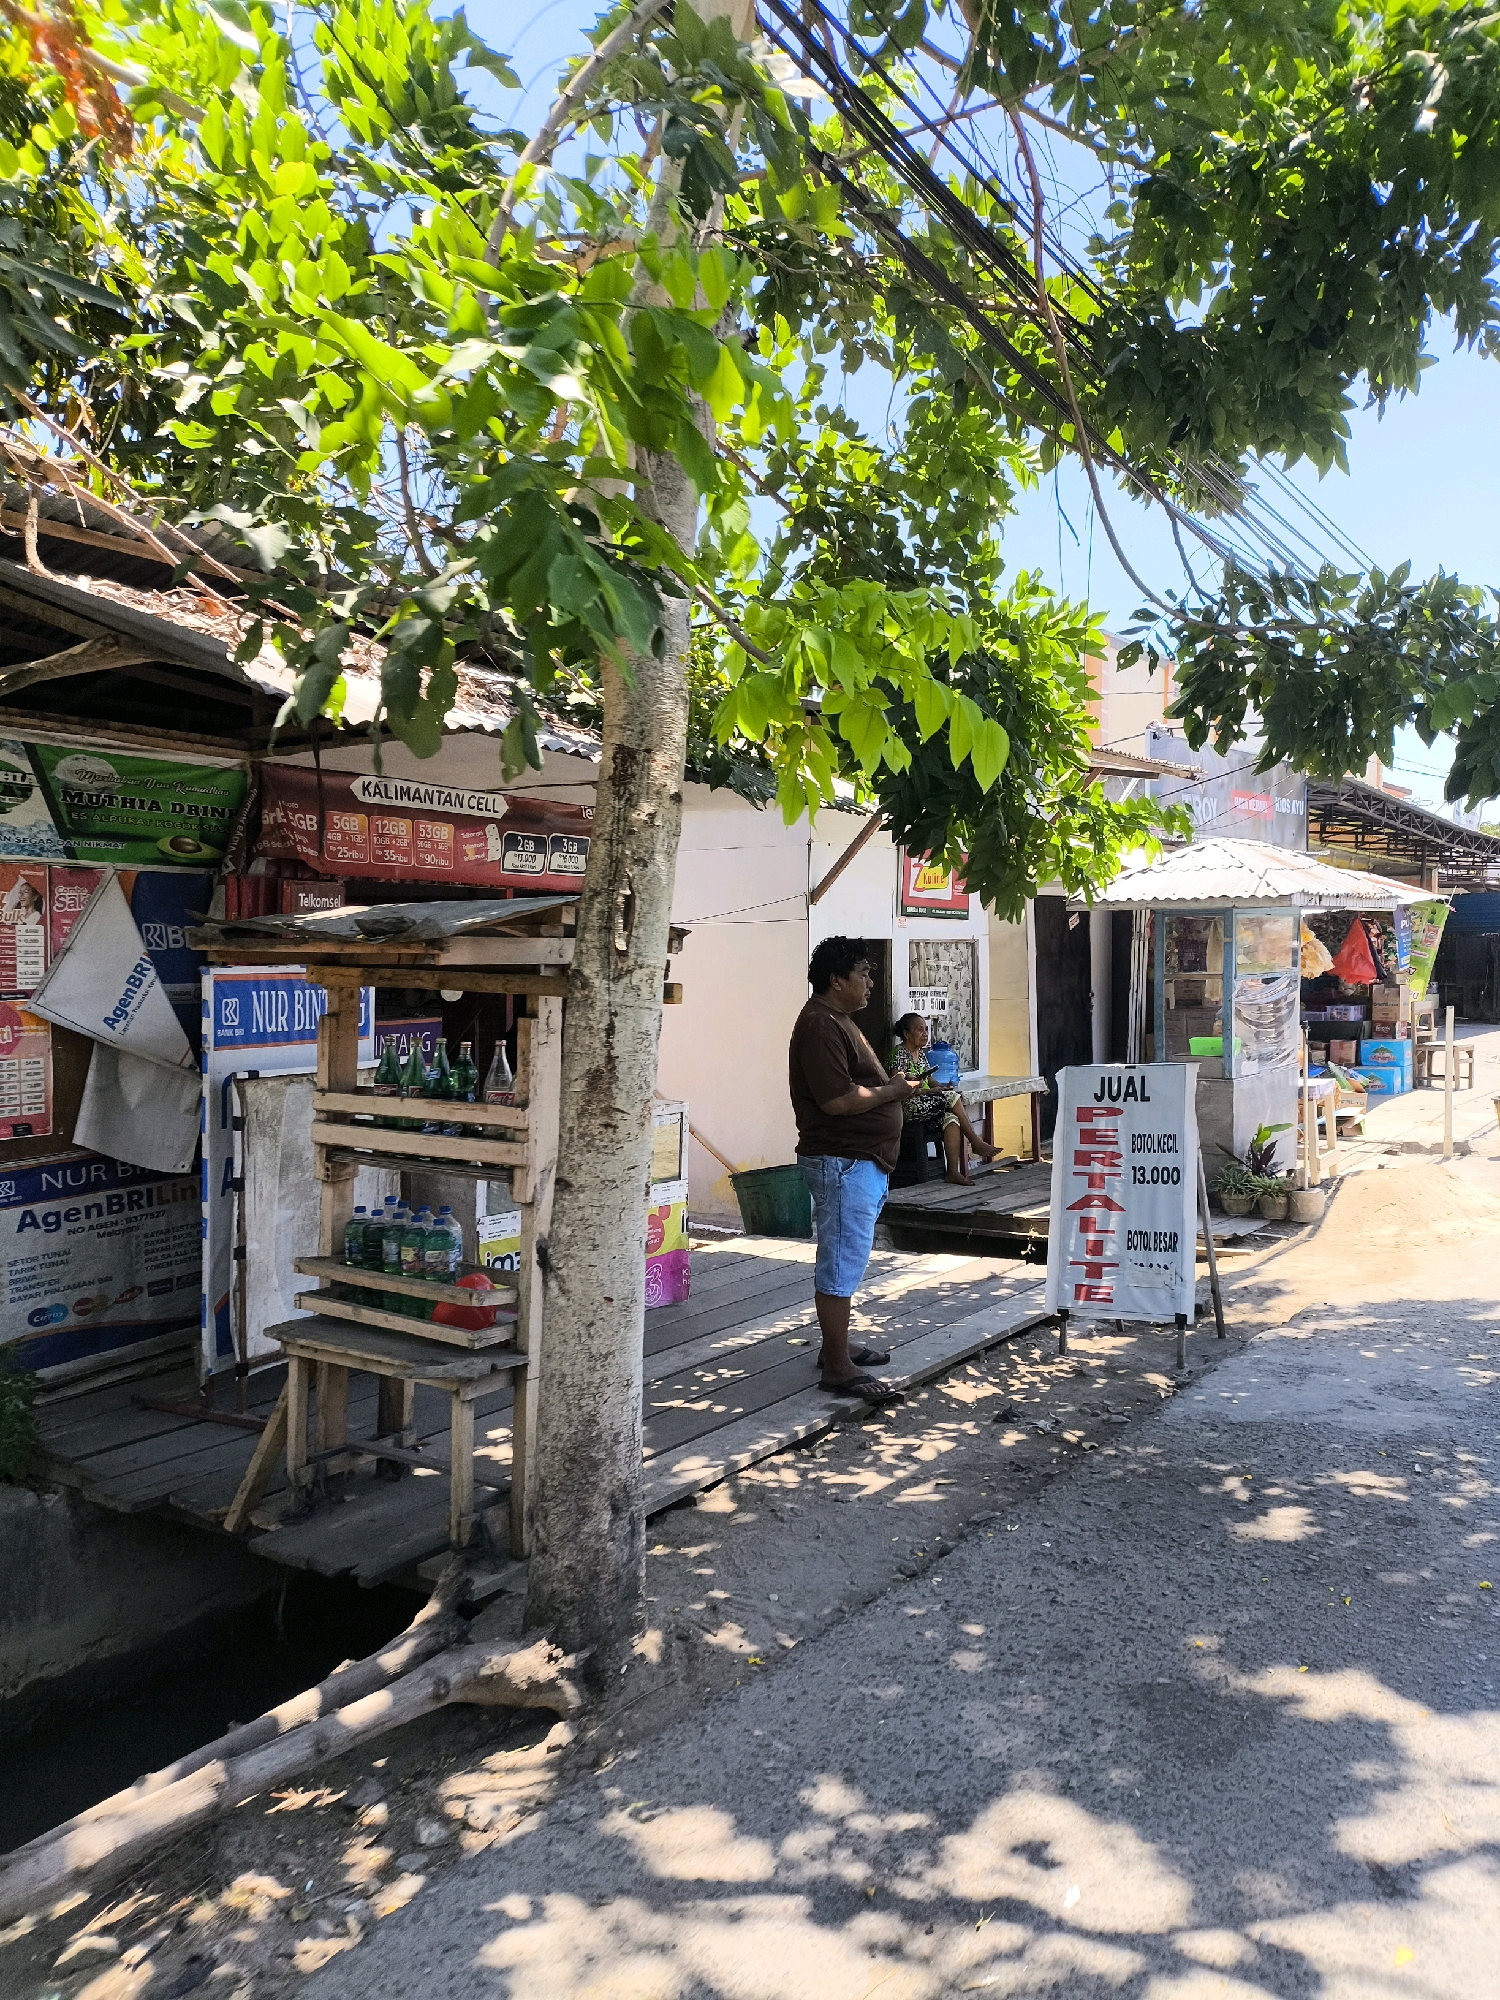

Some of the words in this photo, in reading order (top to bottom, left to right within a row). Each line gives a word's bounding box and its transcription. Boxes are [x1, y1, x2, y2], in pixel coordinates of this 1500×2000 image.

[60, 789, 163, 813] MUTHIA
[361, 780, 465, 809] KALIMANTAN
[467, 794, 500, 814] CELL
[1291, 799, 1305, 816] AYU
[71, 812, 87, 820] ES
[92, 814, 154, 826] ALPUKAT
[156, 820, 200, 831] KOCOK
[332, 815, 359, 831] 5GB
[375, 820, 407, 836] 12GB
[326, 832, 342, 841] 4GB
[419, 824, 449, 840] 53GB
[15, 836, 54, 846] SEGAR
[57, 838, 81, 847] DAN
[84, 840, 126, 849] NIKMAT
[56, 885, 88, 895] Combo
[298, 892, 341, 908] Telkomsel
[102, 951, 154, 1032] AgenBRI
[251, 990, 289, 1033] NUR
[217, 1029, 234, 1037] BANK
[1093, 1075, 1151, 1103] JUAL
[1131, 1133, 1157, 1154] BOTOL
[1157, 1133, 1179, 1154] KECIL
[41, 1164, 107, 1192] NUR
[1131, 1165, 1181, 1186] 13.000
[1065, 1106, 1127, 1304] PERTALITE
[67, 1226, 86, 1236] NO
[88, 1220, 119, 1232] AGEN
[1127, 1230, 1151, 1251] BOTOL
[1153, 1231, 1178, 1253] BESAR
[7, 1255, 40, 1268] SETOR
[42, 1248, 72, 1260] TUNAI
[8, 1265, 37, 1277] TARIK
[40, 1259, 70, 1270] TUNAI
[9, 1278, 61, 1294] TRANSFER
[10, 1291, 43, 1304] BAYAR
[44, 1279, 96, 1297] PINJAMAN
